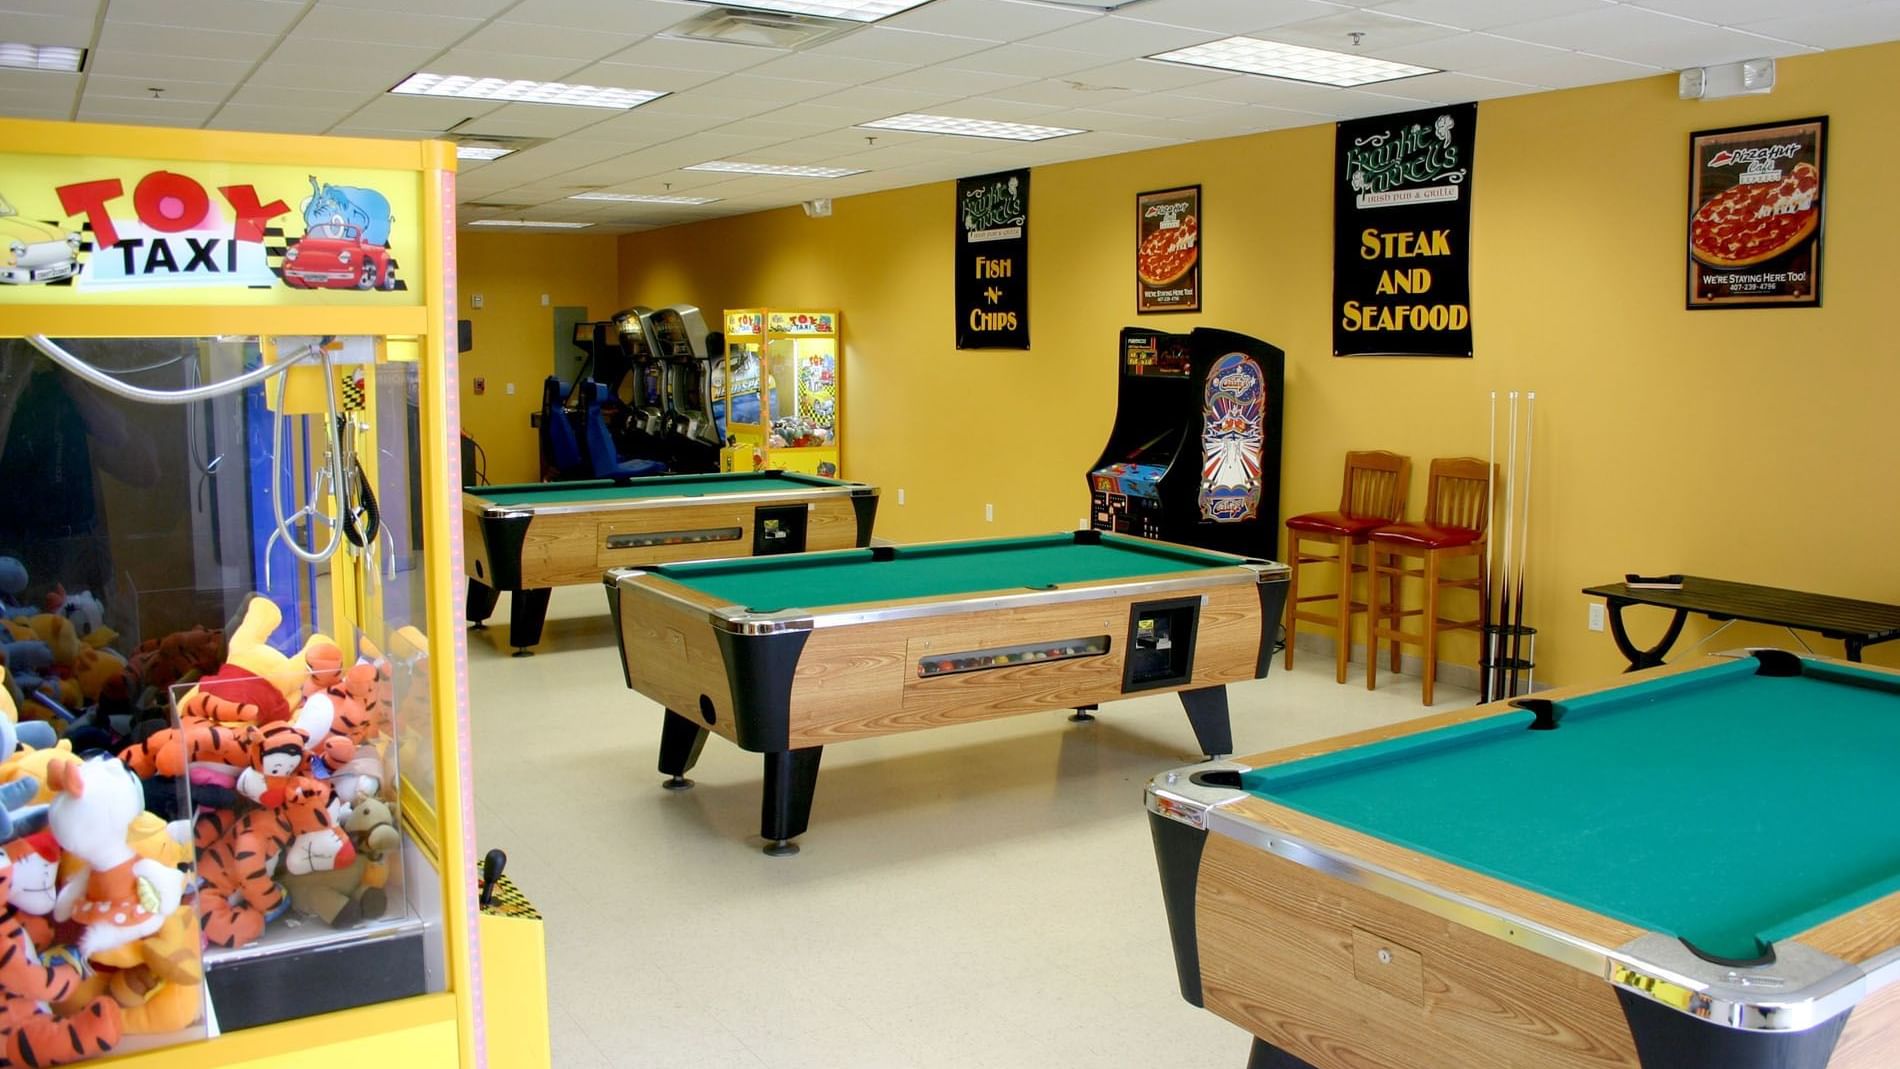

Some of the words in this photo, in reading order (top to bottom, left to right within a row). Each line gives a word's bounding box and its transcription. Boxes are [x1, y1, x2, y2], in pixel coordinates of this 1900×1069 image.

[1346, 126, 1432, 180] Frankie
[1731, 148, 1768, 165] Pizza
[1767, 143, 1801, 159] Hut
[56, 170, 291, 250] TOY
[112, 238, 238, 275] TAXI
[1360, 228, 1452, 260] STEAK
[975, 256, 1012, 279] FISH
[1729, 273, 1761, 284] STAYING
[1763, 272, 1786, 283] HERE
[1375, 268, 1432, 295] AND
[789, 314, 818, 325] TOY
[970, 308, 1017, 332] CHIPS
[1342, 300, 1468, 332] SEAFOOD
